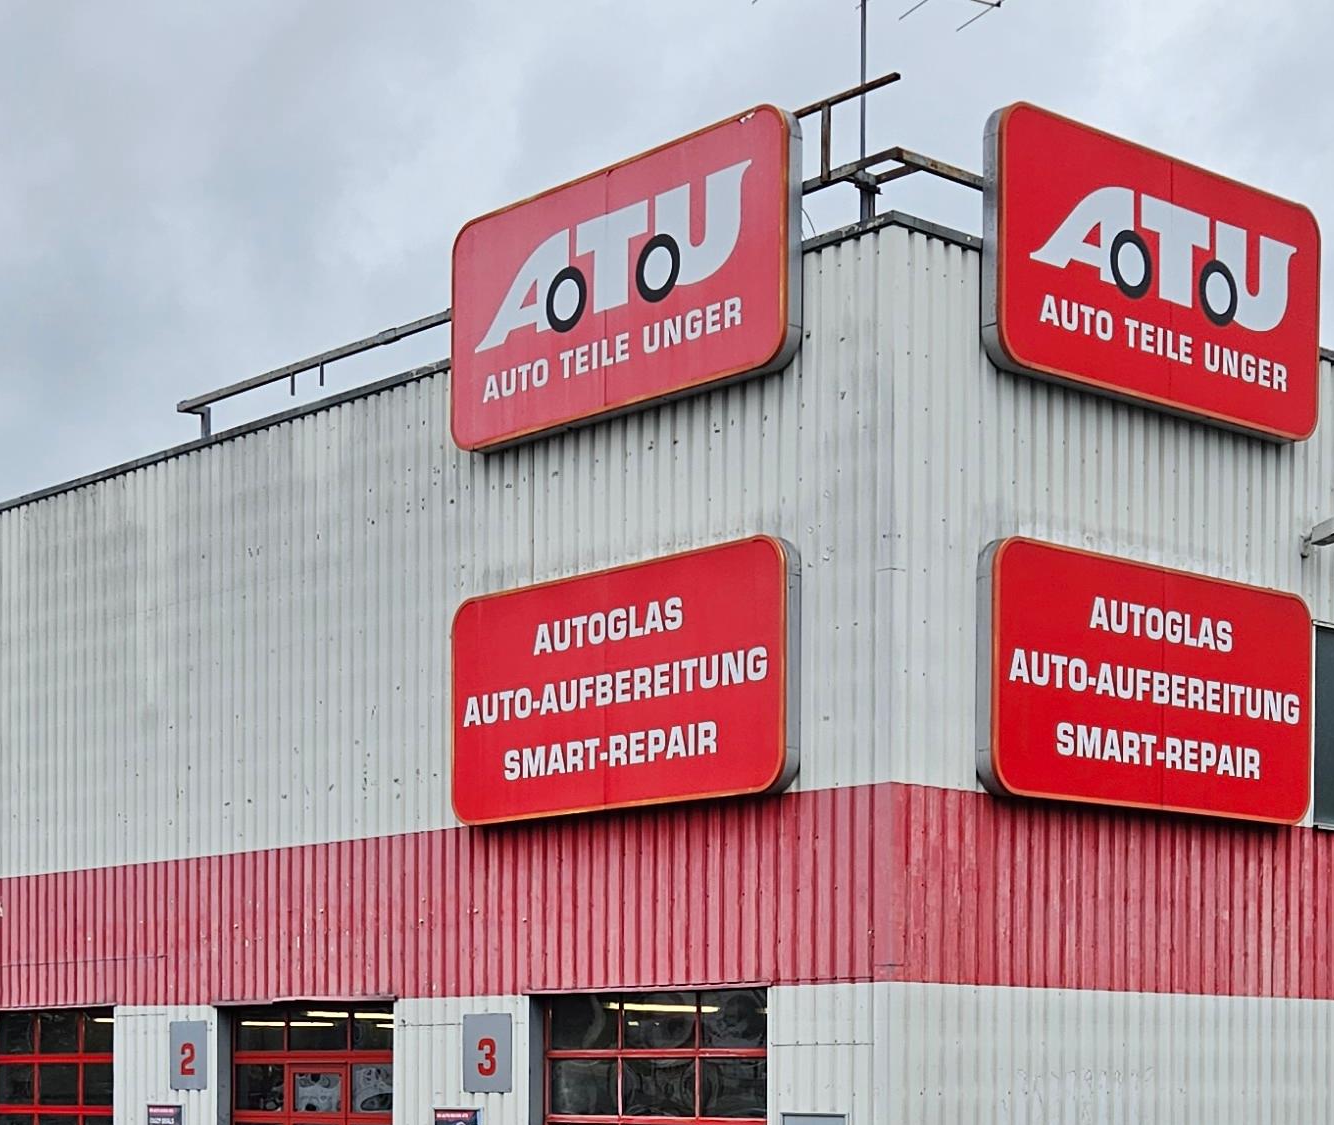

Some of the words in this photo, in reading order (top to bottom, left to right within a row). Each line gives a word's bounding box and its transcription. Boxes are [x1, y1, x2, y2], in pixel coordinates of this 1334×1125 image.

[482, 358, 549, 403] AUTO
[560, 332, 629, 379] TEILE
[643, 297, 742, 354] UNGER
[1039, 294, 1113, 341] AUTO
[1124, 317, 1193, 364] TEILE
[1204, 342, 1288, 393] UNGER
[533, 596, 683, 656] AUTOGLAS
[1089, 596, 1233, 652] AUTOGLAS
[463, 646, 768, 727] AUTO-AUFBEREITUNG
[1009, 648, 1300, 725] AUTO-AUFBEREITUNG
[504, 721, 717, 781] SMART-REPAIR
[1056, 721, 1260, 780] SMART-REPAIR
[180, 1043, 195, 1075] 2
[477, 1038, 496, 1076] 3
